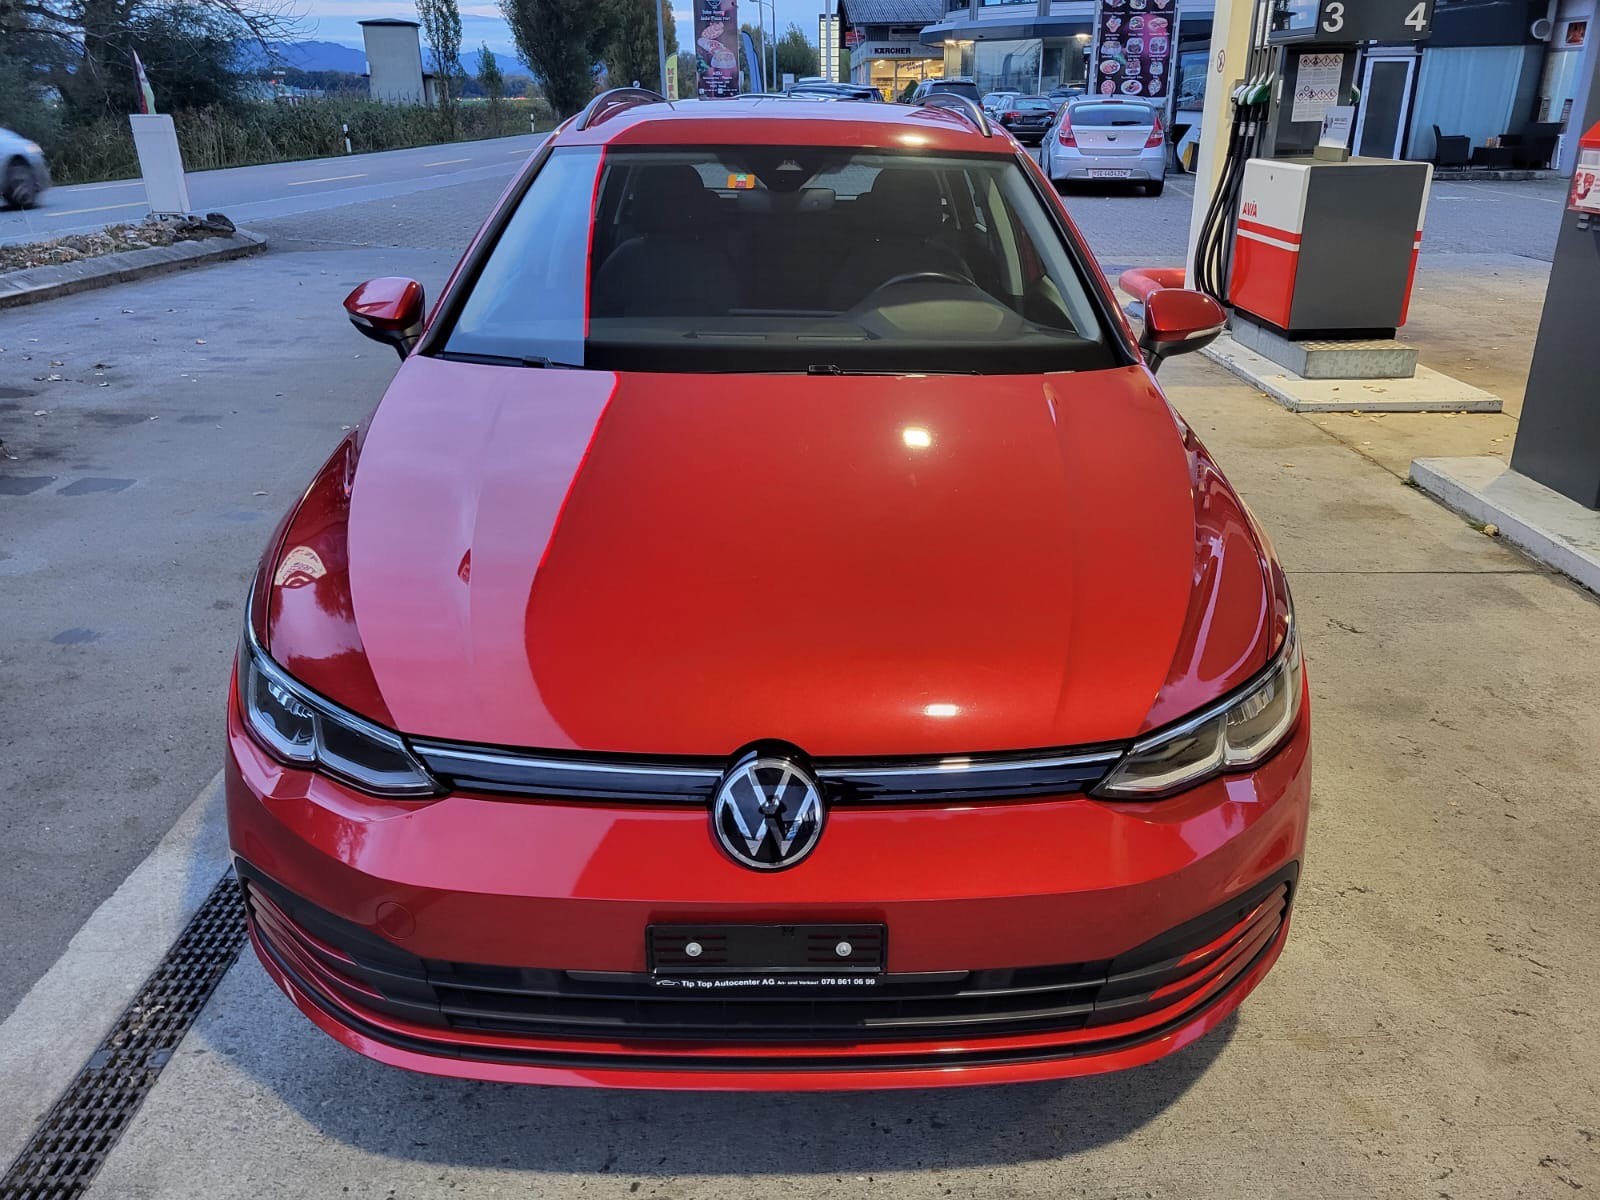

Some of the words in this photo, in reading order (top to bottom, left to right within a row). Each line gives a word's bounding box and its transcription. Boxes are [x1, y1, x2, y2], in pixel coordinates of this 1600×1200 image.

[1322, 2, 1345, 33] 3
[1404, 2, 1427, 32] 4
[1242, 200, 1258, 218] AVIA
[681, 980, 695, 988] Tip
[697, 980, 713, 988] Top
[714, 979, 760, 987] Autocenter
[762, 978, 775, 986] AG
